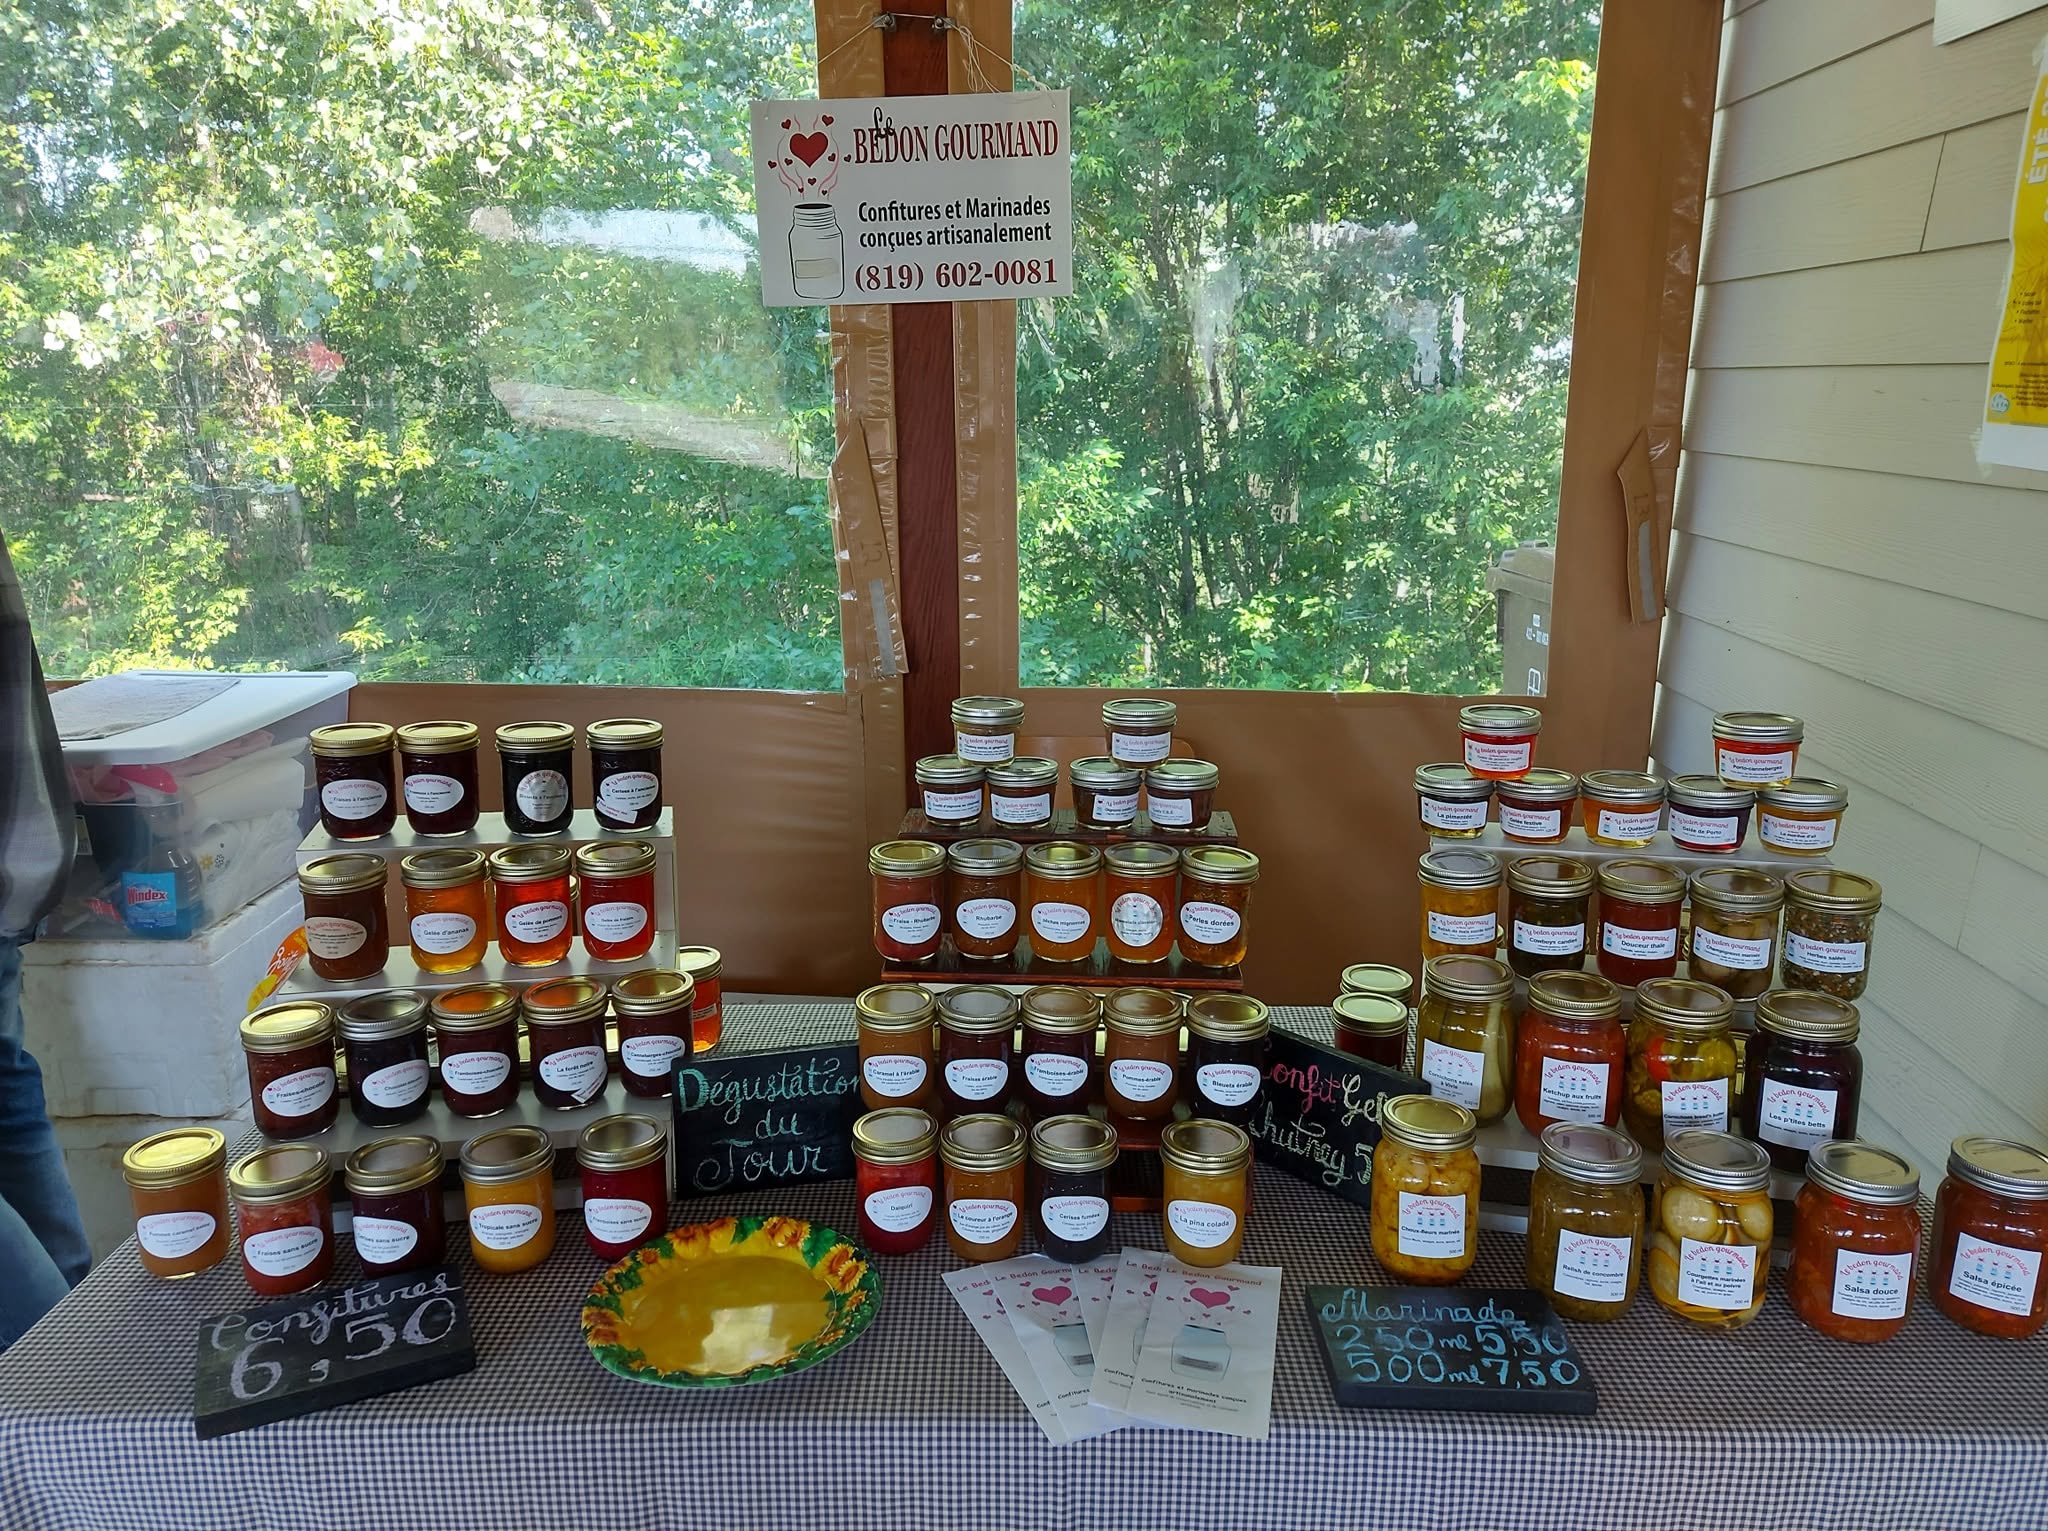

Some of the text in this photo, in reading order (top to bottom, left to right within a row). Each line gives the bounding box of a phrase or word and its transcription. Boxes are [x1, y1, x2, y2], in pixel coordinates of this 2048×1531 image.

[853, 120, 1059, 164] BEDON GOURMAND
[858, 196, 1051, 222] Confitures et Marinades
[859, 222, 1051, 252] conçues artisanalement
[855, 259, 1057, 293] (819) 602-0081
[127, 886, 168, 905] Windex
[1189, 915, 1208, 924] Perles
[442, 928, 469, 936] d'ananas
[564, 1063, 579, 1072] forêt
[873, 1068, 894, 1076] Caramel
[1551, 1064, 1571, 1074] bedon
[1572, 1064, 1601, 1085] gourmand
[1262, 1063, 1341, 1114] onfit
[1543, 1088, 1570, 1098] Ketchup
[1671, 1084, 1691, 1097] bedon
[1692, 1083, 1722, 1101] gourmand
[1773, 1088, 1796, 1100] bedon
[1797, 1090, 1830, 1114] gourmand
[755, 1108, 803, 1139] du
[1770, 1112, 1782, 1121] Les
[1409, 1199, 1428, 1211] bedon
[1429, 1199, 1460, 1220] gourmand
[283, 1247, 300, 1255] sans
[1570, 1238, 1594, 1249] bedon
[1595, 1239, 1624, 1261] gourmand
[1692, 1246, 1713, 1257] bedon
[1715, 1246, 1749, 1269] gourmand
[1126, 1260, 1138, 1269] Le
[1562, 1264, 1582, 1274] Relish
[1848, 1259, 1872, 1272] bedon
[1873, 1259, 1904, 1281] gourmand
[1968, 1246, 1994, 1257] bedon
[1995, 1248, 2031, 1277] gourmand
[994, 1274, 1006, 1282] Le
[1009, 1270, 1038, 1279] Bedon
[1182, 1269, 1211, 1279] Bedon
[1214, 1274, 1263, 1287] Gourmand
[1963, 1271, 1989, 1285] Salsa
[1991, 1279, 2022, 1293] épicée
[956, 1285, 970, 1293] Le
[1844, 1284, 1870, 1295] Salsa
[1336, 1324, 1434, 1350] 250
[1347, 1351, 1445, 1383] 500
[1481, 1357, 1581, 1389] 7,50
